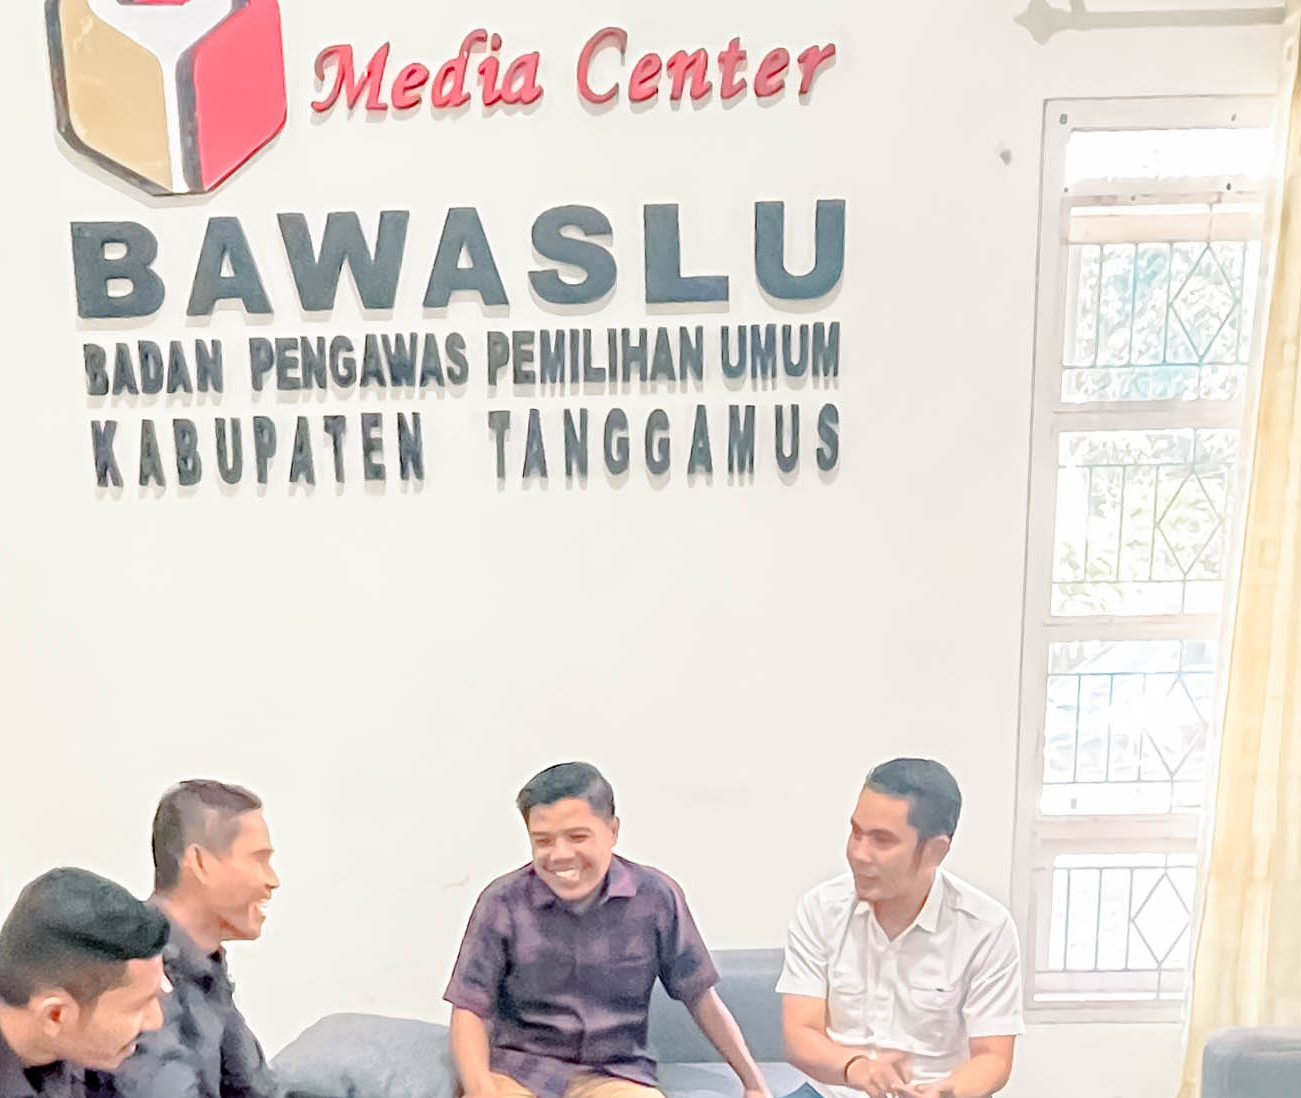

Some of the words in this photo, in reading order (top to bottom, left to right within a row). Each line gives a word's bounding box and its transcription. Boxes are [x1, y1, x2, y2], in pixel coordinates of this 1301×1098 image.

[311, 28, 544, 112] Media
[576, 26, 837, 104] Center
[70, 200, 846, 320] BAWASLU
[83, 338, 223, 396] BADAN
[248, 332, 469, 392] PENGAWAS
[487, 324, 704, 386] PEMILIHAN
[720, 321, 840, 379] UMUM
[90, 411, 425, 488] KABUPATEN
[488, 403, 840, 479] TANGGAMUS
